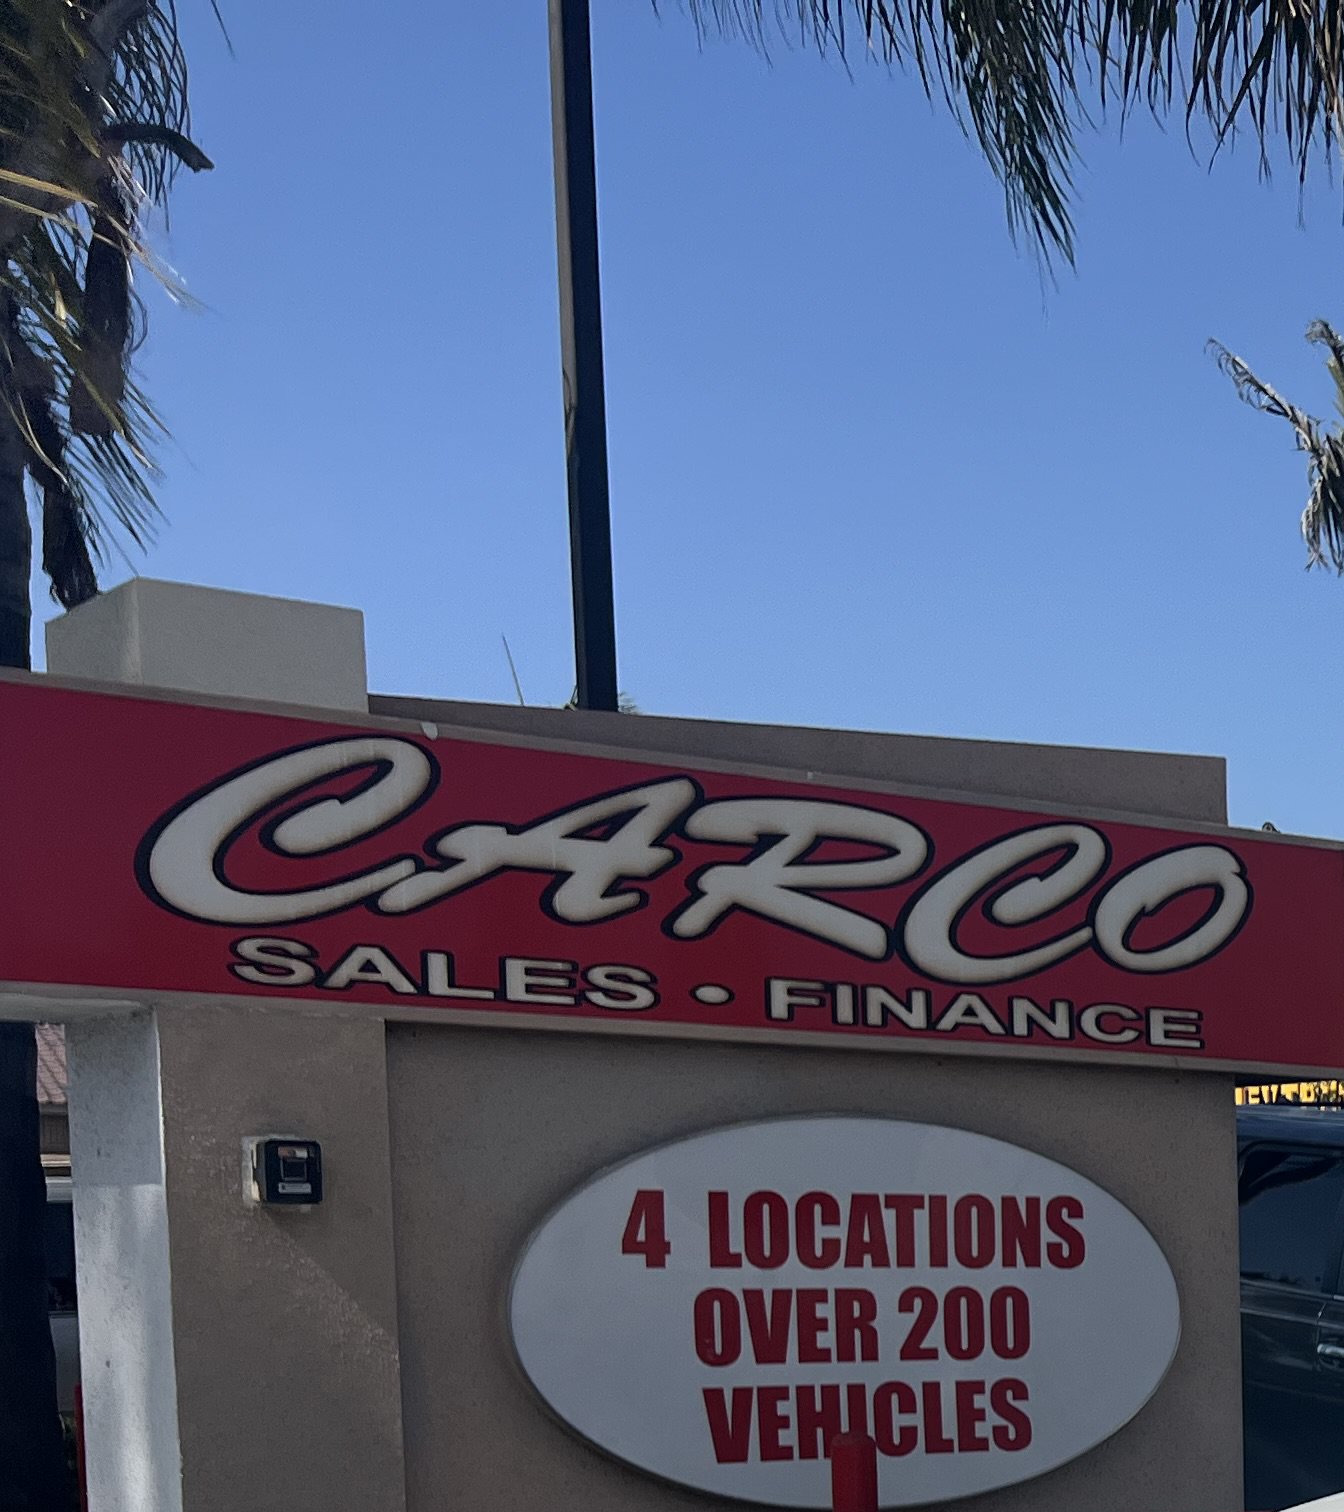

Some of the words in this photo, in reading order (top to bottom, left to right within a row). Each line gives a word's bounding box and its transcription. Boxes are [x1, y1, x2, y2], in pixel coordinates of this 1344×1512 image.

[133, 733, 1254, 986] CARCO
[228, 931, 660, 1013] SALES
[765, 974, 1208, 1052] FINANCE
[621, 1190, 671, 1268] 4
[707, 1190, 1086, 1269] LOCATIONS
[693, 1287, 879, 1367] OVER
[897, 1286, 1032, 1362] 200
[702, 1378, 1033, 1464] VEHICLES
